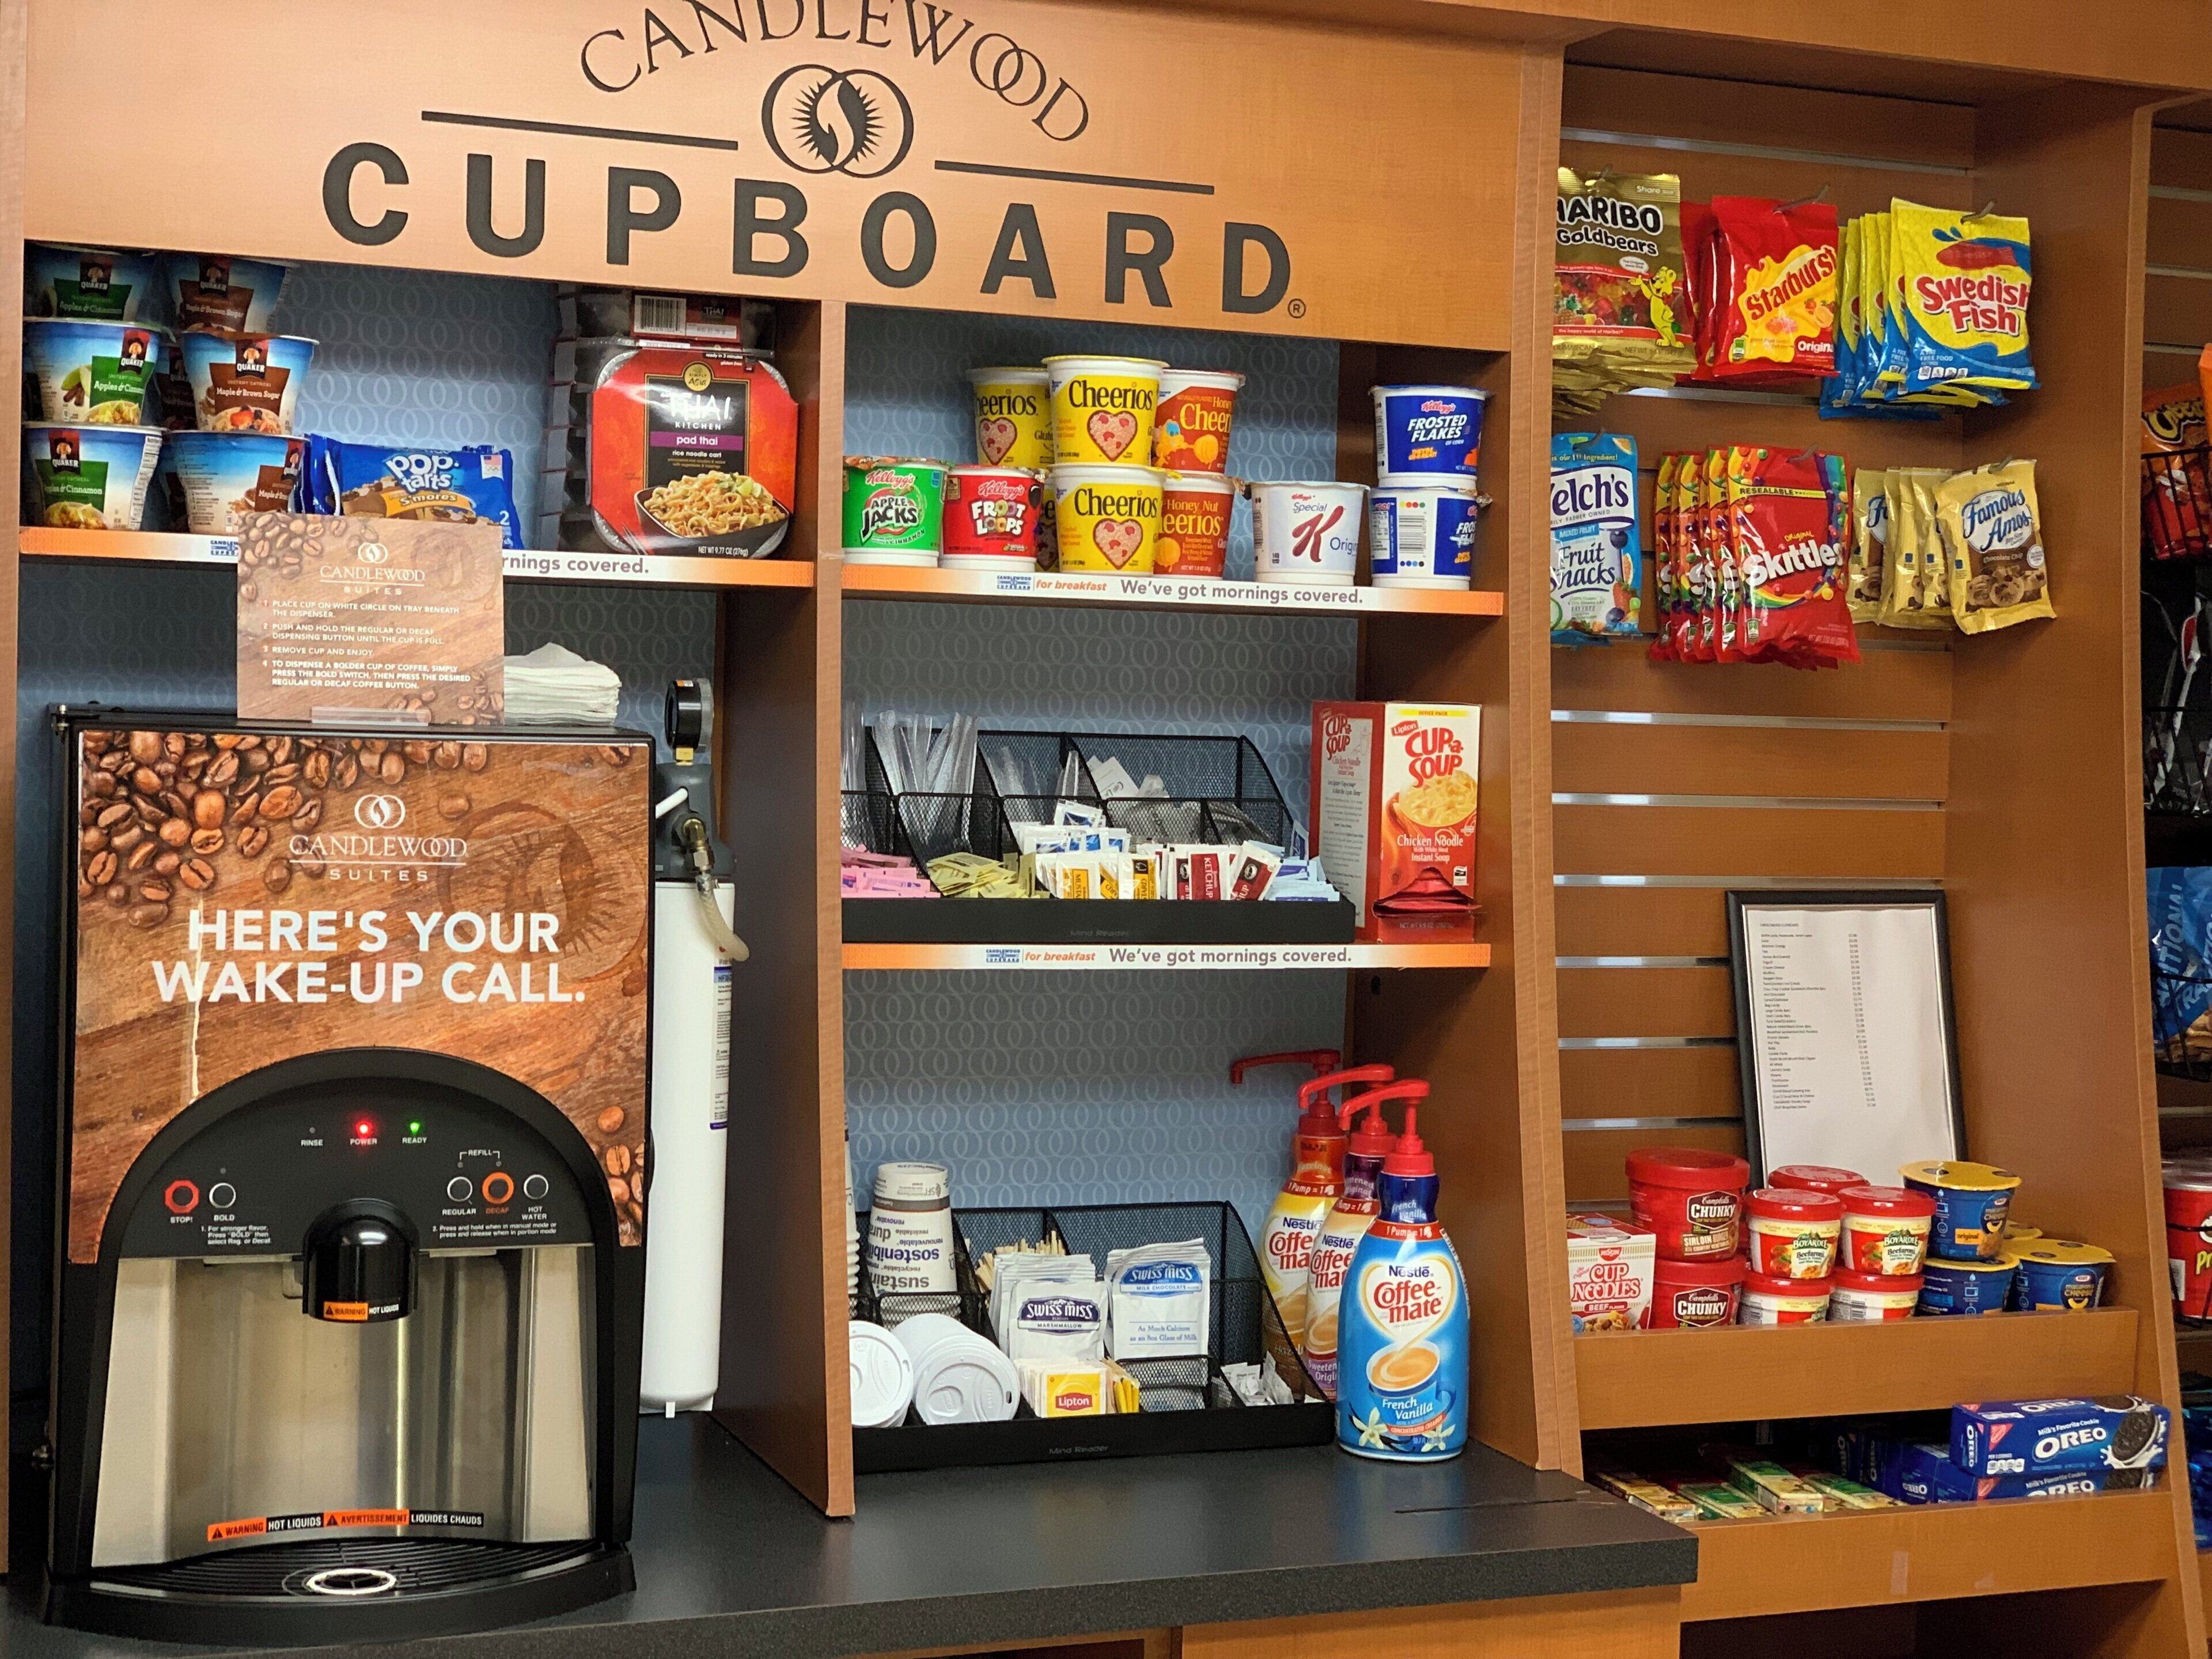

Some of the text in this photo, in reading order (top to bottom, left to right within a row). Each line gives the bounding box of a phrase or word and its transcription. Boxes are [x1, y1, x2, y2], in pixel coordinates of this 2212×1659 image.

[581, 0, 1088, 141] CANDLEWOOD
[1636, 185, 1660, 194] Share
[323, 142, 1291, 315] CUPBOARD
[1556, 225, 1659, 257] Goldbears
[81, 281, 108, 290] QUAKER
[200, 281, 227, 291] QUAKER
[1745, 245, 1838, 320] Starburst
[1916, 274, 2031, 314] Swedish
[1946, 300, 2021, 336] Fish
[120, 358, 144, 368] QUAKER
[237, 362, 265, 373] QUAKER
[217, 387, 281, 402] Maple Brown Sugar
[1069, 380, 1153, 410] Cheerios
[661, 392, 732, 421] THAI
[1421, 400, 1456, 414] Kellogg's
[675, 421, 722, 431] KITCHEN
[1407, 414, 1468, 432] FROSTED
[676, 434, 719, 446] pad thai
[1411, 425, 1463, 443] FLAKES
[685, 450, 708, 459] noodle
[52, 458, 78, 468] QUAKER
[865, 470, 915, 488] Kellogg's
[978, 480, 1025, 499] Kellogg's
[1740, 487, 1794, 496] RESEALABLE
[399, 493, 457, 506] S'mores
[871, 496, 908, 507] APPLE
[1074, 488, 1158, 518] Cheerios
[1166, 499, 1219, 514] Honey Nut
[971, 499, 1026, 520] FROOT
[1293, 502, 1327, 513] Special
[1961, 488, 2026, 539] Famous
[499, 510, 510, 525] 2
[862, 506, 919, 539] JACKS
[1565, 509, 1611, 522] FARMER OWNED
[976, 517, 1025, 535] LOOPS
[1559, 525, 1596, 539] MIXED FRUIT
[1980, 510, 2032, 551] Amos
[1292, 505, 1344, 563] K
[1558, 542, 1605, 568] Fruit
[1743, 539, 1843, 586] Skittles
[1983, 554, 2011, 563] Chocolate
[320, 565, 425, 582] CANDLEWOOD
[567, 558, 649, 574] covered.
[343, 586, 402, 596] SUITES
[1036, 579, 1107, 592] for breakfast
[1121, 579, 1363, 604] We've got mornings covered.
[272, 600, 298, 608] PLACE
[360, 603, 387, 611] CIRCLE
[424, 606, 460, 614] BENEATH
[290, 610, 336, 618] DISPENSER.
[272, 646, 306, 654] REMOVE
[1393, 723, 1417, 735] Lipton
[1404, 728, 1454, 758] CUP
[1408, 754, 1463, 789] SOUP
[289, 835, 467, 857] CANDLEWOOD
[1397, 834, 1464, 847] Chicken Noodle
[1411, 854, 1450, 863] Instant Soup
[329, 868, 429, 882] SUITES
[1204, 857, 1213, 898] KETCHUP
[188, 909, 560, 953] HERE'S YOUR
[1109, 947, 1352, 967] We've got mornings covered.
[152, 961, 586, 1003] WAKE-UP CALL.
[1392, 1200, 1417, 1213] French
[1702, 1195, 1730, 1205] Campbell's
[1399, 1209, 1427, 1220] Vanilla
[1691, 1203, 1736, 1218] CHUNKY
[1684, 1235, 1712, 1247] SIRLOIN
[1793, 1239, 1828, 1249] BOYARDEE
[1884, 1236, 1919, 1247] BOYARDEE
[1957, 1233, 1979, 1241] original
[1797, 1251, 1825, 1259] Beefaroni
[1130, 1266, 1193, 1282] SWISS MISS
[1589, 1263, 1630, 1282] CUP
[1571, 1278, 1641, 1302] NOODLES
[1688, 1293, 1718, 1302] Campbell's
[369, 1306, 380, 1315] HOT
[1027, 1301, 1093, 1320] SWISS MISS
[1389, 1297, 1442, 1323] mate
[1588, 1303, 1608, 1312] BEEF
[1677, 1300, 1727, 1316] CHUNKY
[1058, 1396, 1090, 1408] Lipton
[1382, 1397, 1418, 1410] French
[1395, 1402, 1434, 1421] Vanilla
[2037, 1418, 2100, 1436] Milk's Favorite Cookie
[1074, 1445, 1109, 1454] Reader
[2035, 1427, 2107, 1459] OREO
[1902, 1482, 1927, 1495] OREO
[225, 1513, 482, 1536] WARNING HOT LIQUIDS AVERTISSEMENT LIQUIDES CHAUDS
